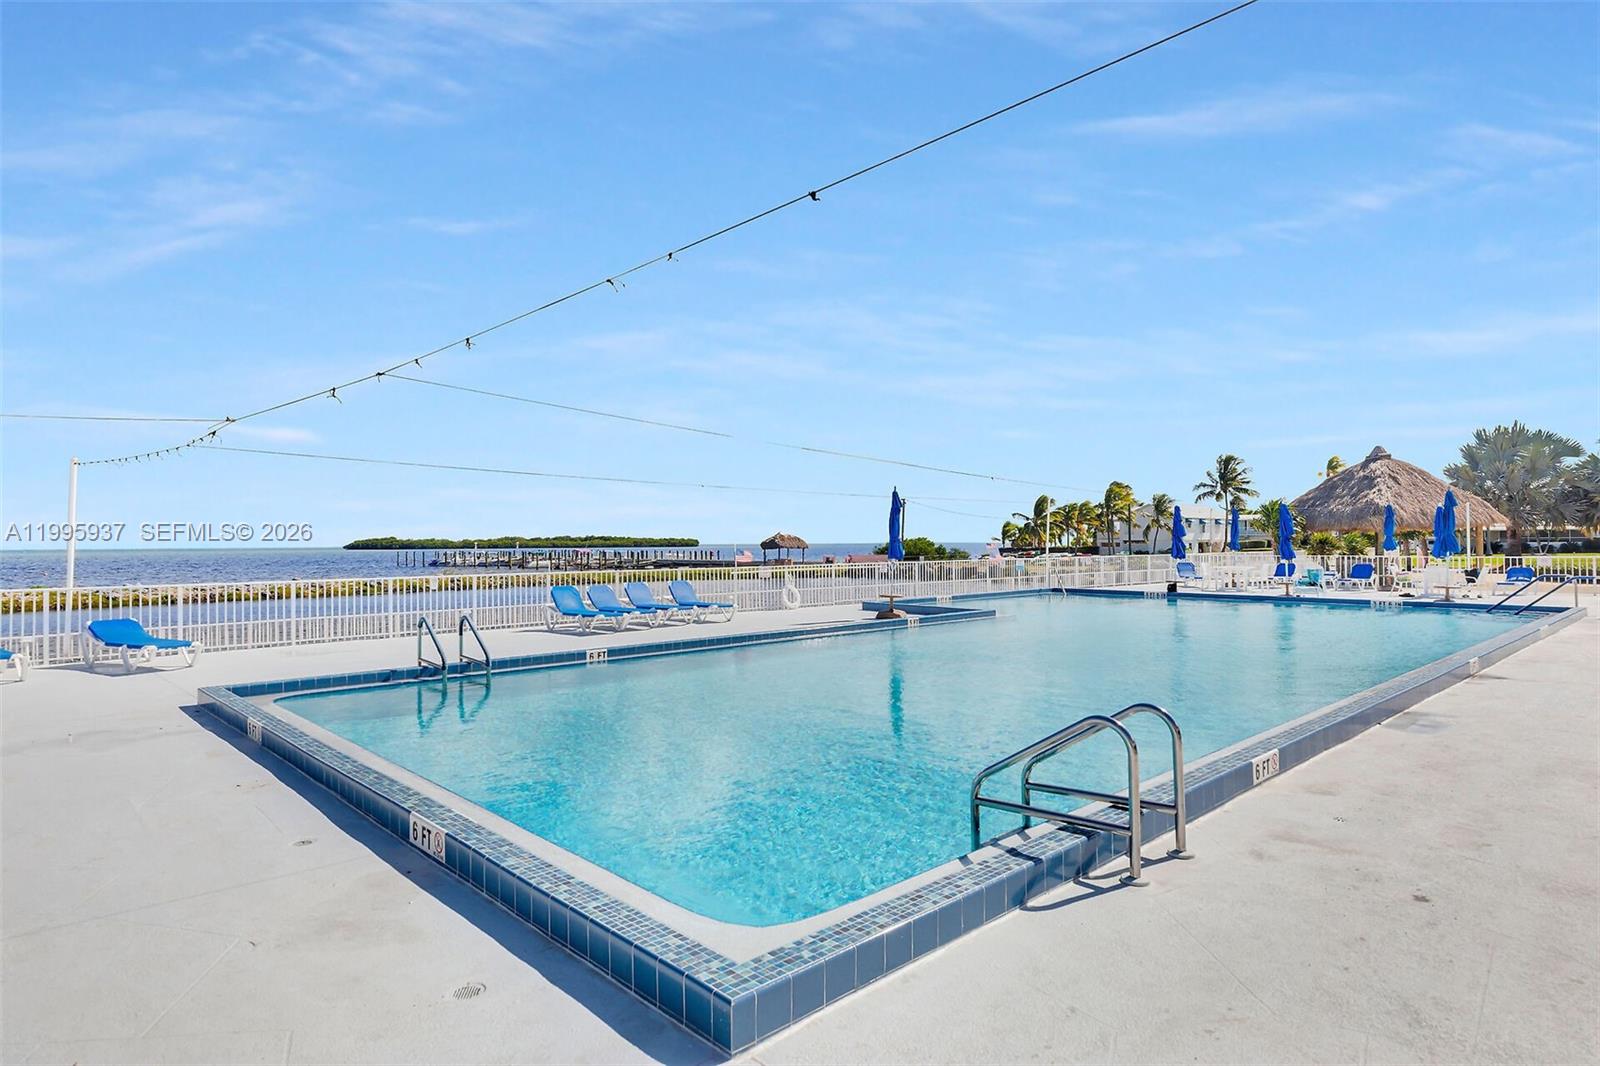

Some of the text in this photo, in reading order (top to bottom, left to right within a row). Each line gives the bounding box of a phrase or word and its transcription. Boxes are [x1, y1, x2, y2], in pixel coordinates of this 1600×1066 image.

[597, 651, 607, 660] FT
[1255, 758, 1270, 780] 6 FT
[412, 821, 432, 850] 6 FT
